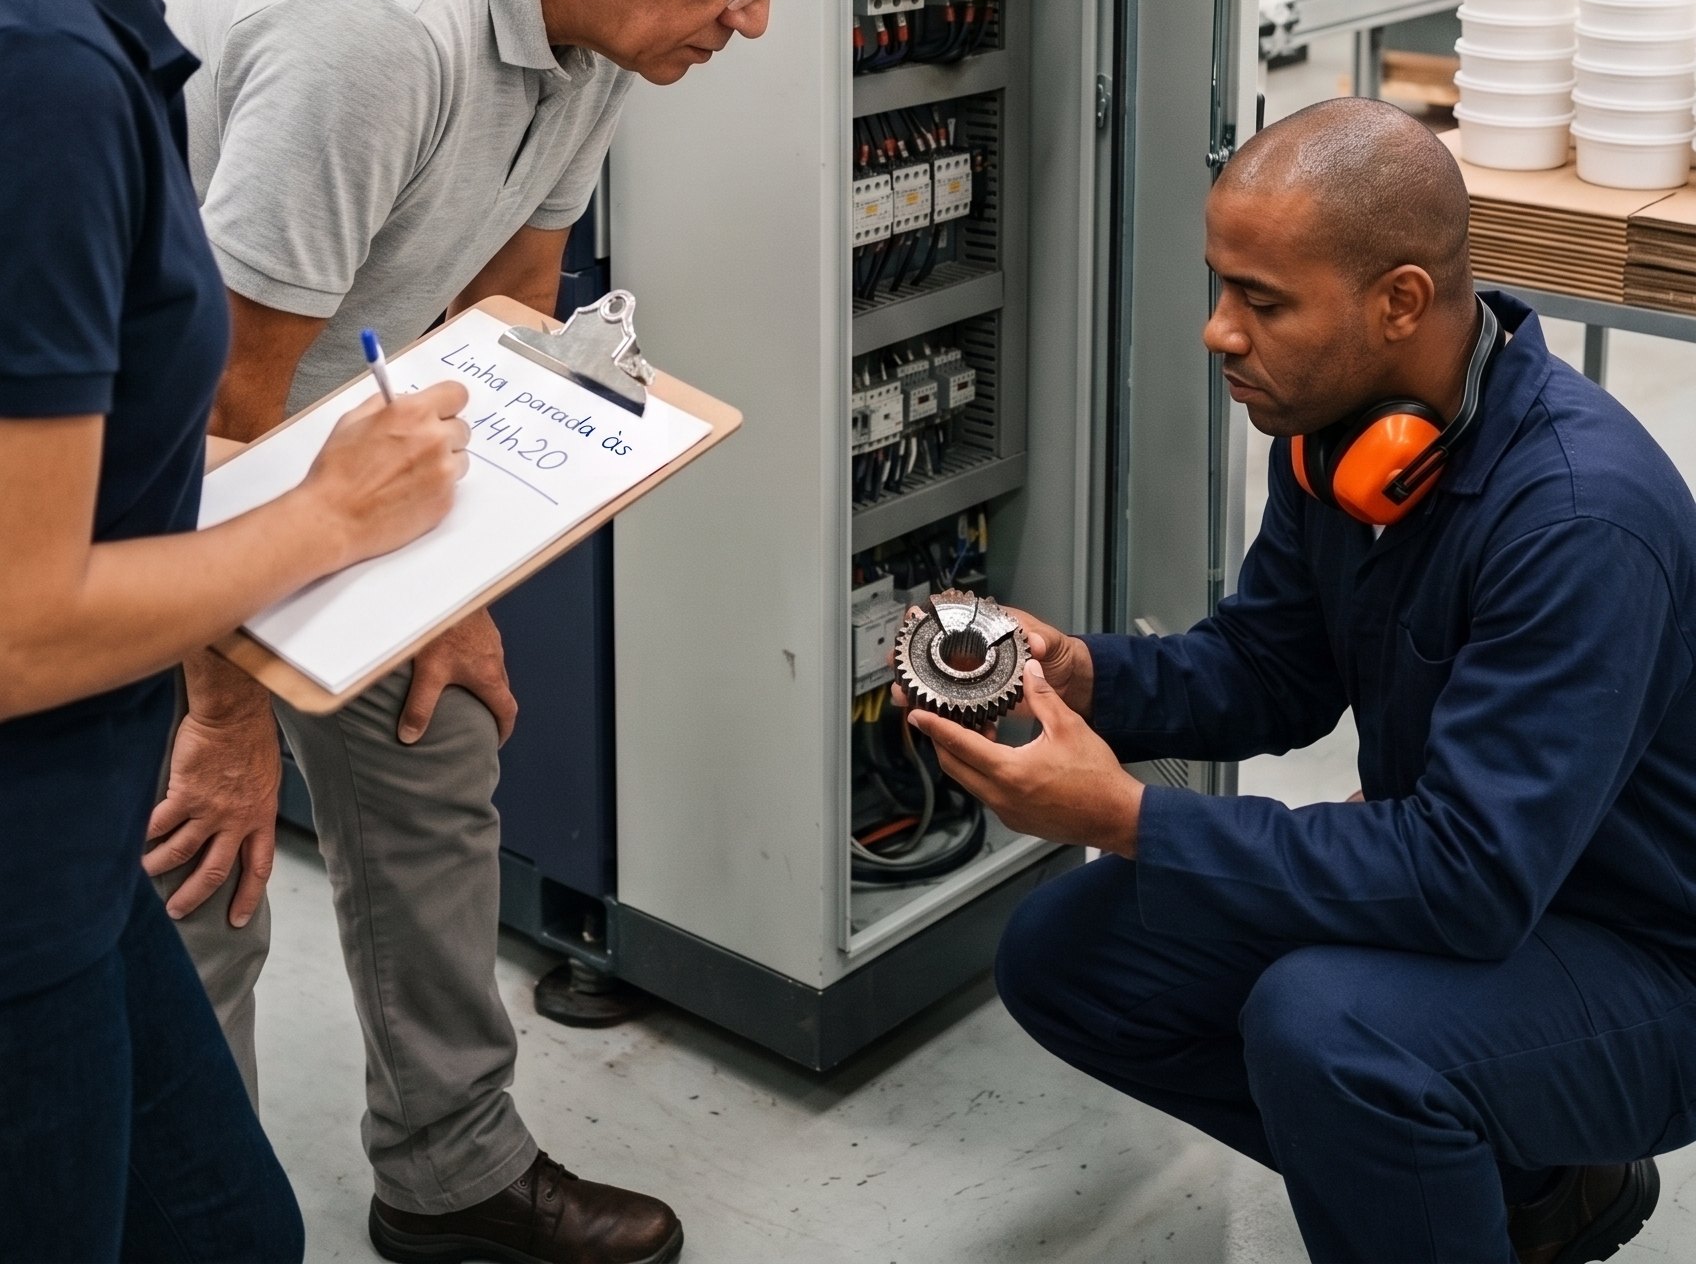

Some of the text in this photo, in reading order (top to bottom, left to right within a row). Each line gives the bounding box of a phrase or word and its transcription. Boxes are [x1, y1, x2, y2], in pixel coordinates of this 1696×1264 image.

[440, 343, 633, 457] Linha parada às
[471, 411, 569, 470] 14h20
